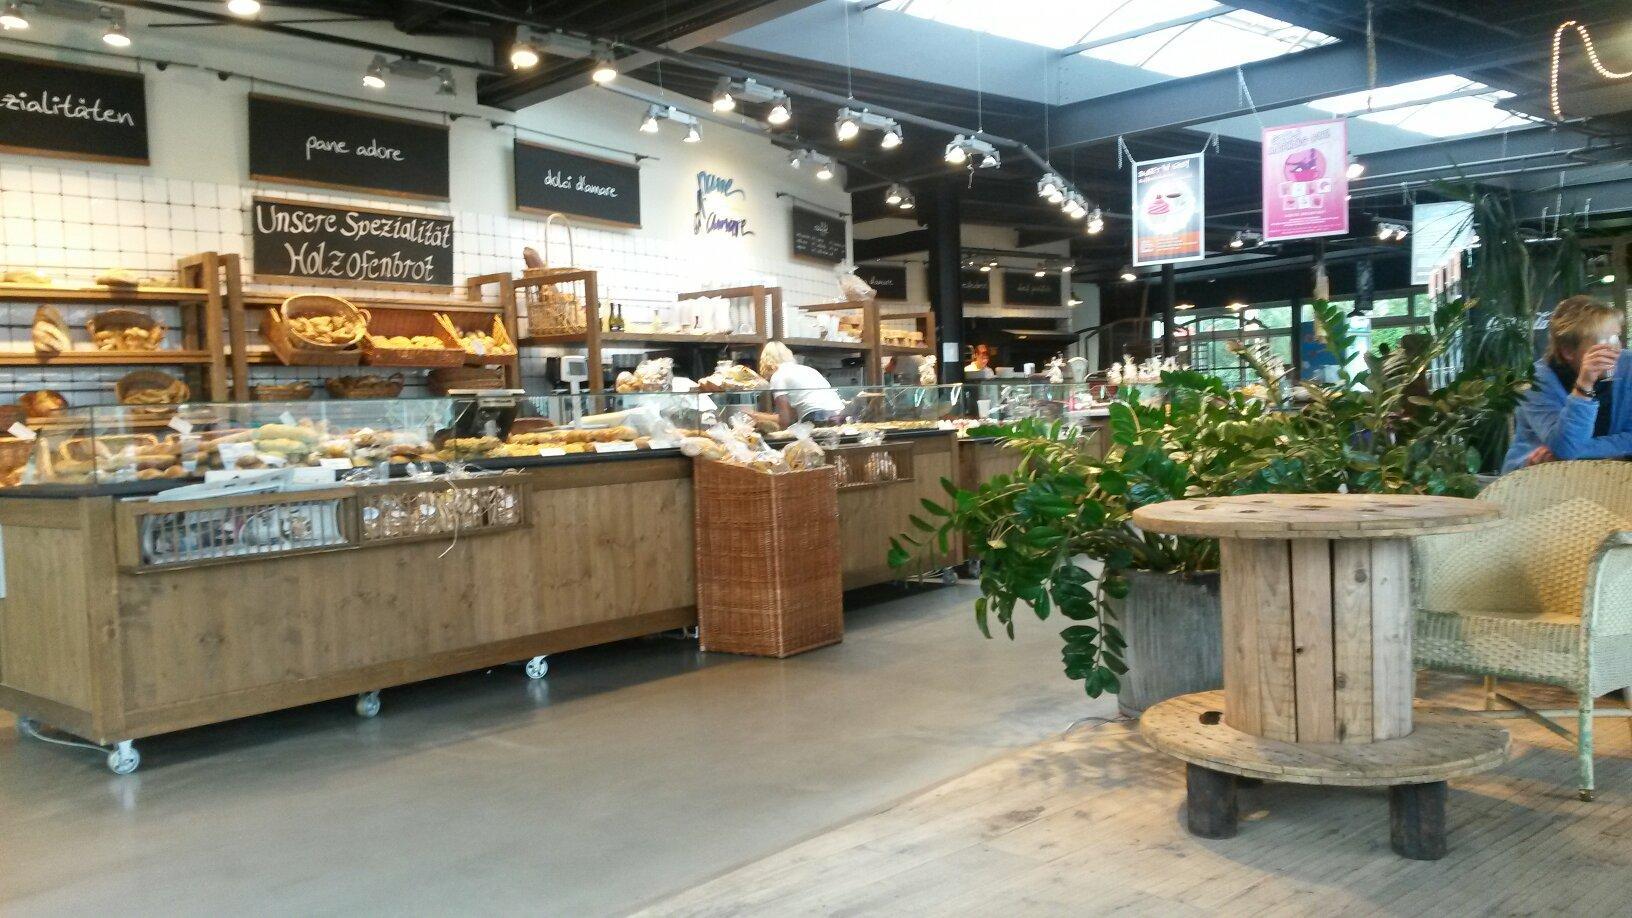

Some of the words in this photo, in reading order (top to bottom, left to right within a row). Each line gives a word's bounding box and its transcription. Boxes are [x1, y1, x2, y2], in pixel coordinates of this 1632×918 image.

[306, 136, 350, 161] pane
[356, 137, 405, 161] adore
[544, 169, 573, 190] dolci
[255, 205, 337, 235] Unsere
[340, 212, 452, 249] Spezialität
